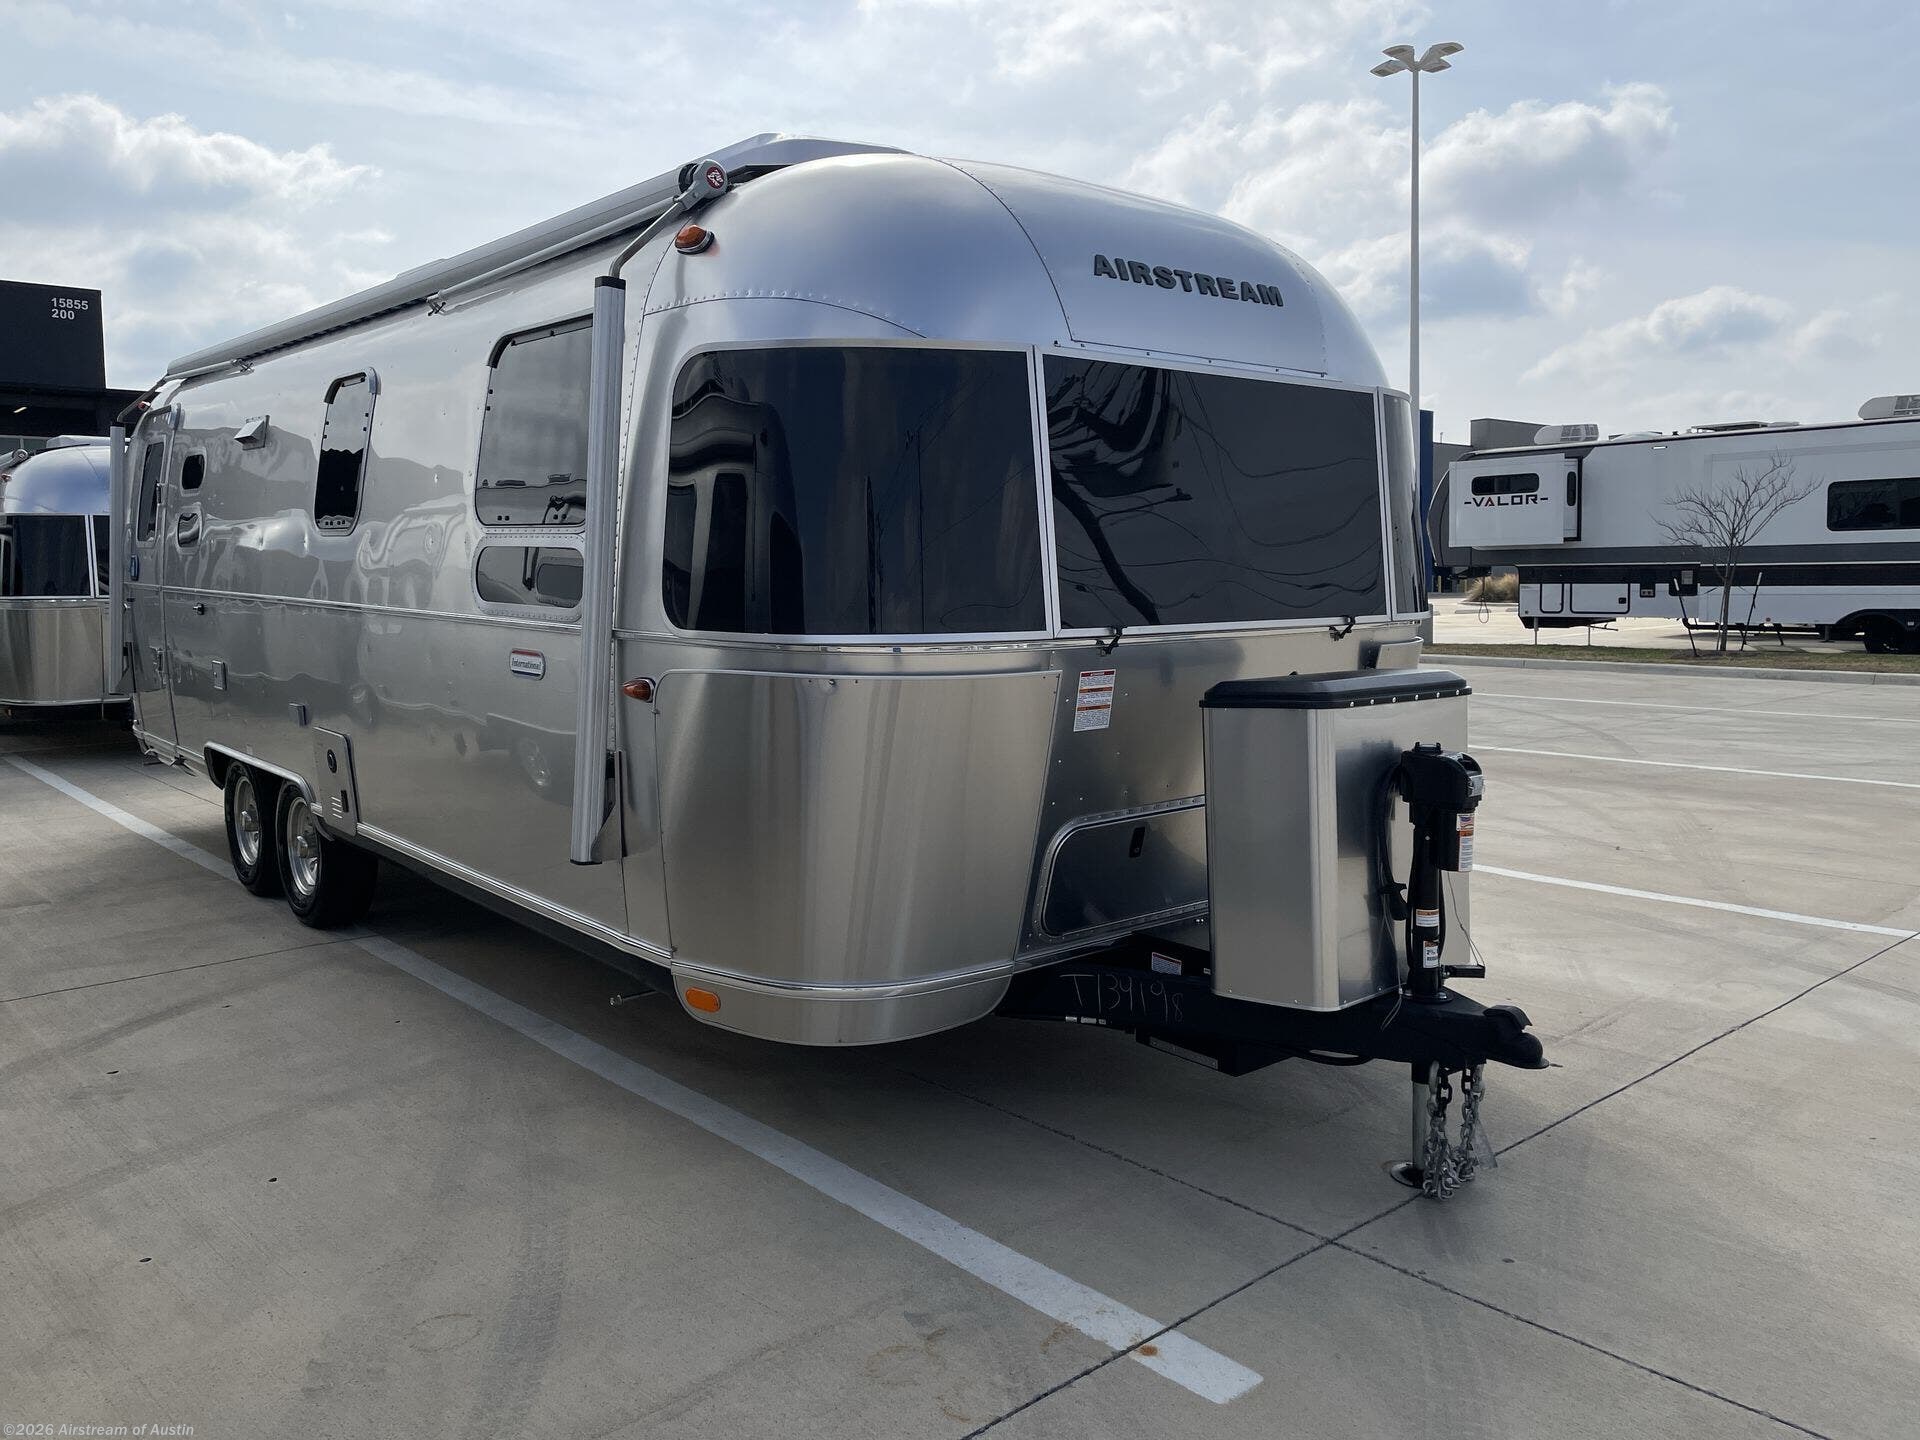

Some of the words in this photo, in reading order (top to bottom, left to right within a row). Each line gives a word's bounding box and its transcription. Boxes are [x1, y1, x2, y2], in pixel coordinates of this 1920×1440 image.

[1094, 254, 1284, 306] AIRSTREAM
[51, 297, 88, 310] 15855
[51, 308, 75, 320] 200
